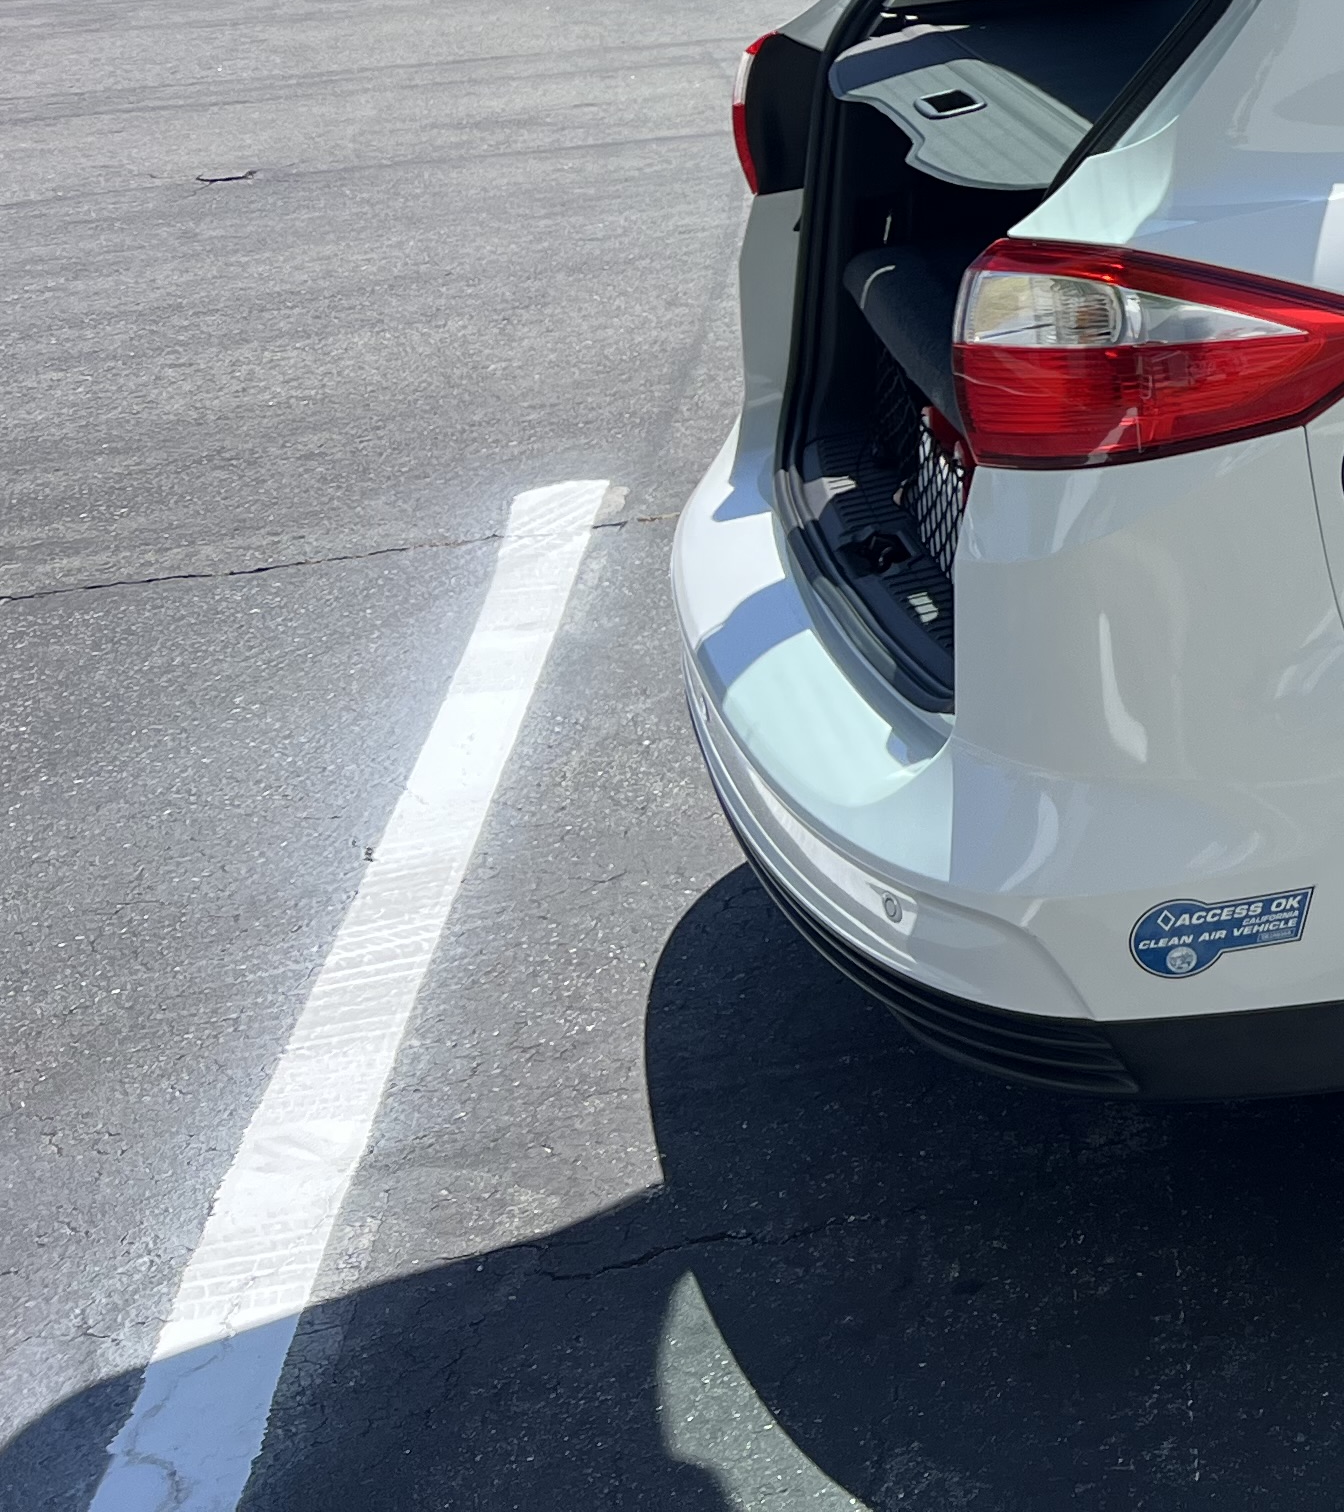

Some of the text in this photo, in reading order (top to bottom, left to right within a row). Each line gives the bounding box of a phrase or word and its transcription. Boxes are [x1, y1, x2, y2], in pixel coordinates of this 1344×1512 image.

[1174, 895, 1302, 927] ACCESS OK
[1242, 910, 1299, 925] CALIFORNIA
[1138, 934, 1193, 949] CLEAN
[1198, 930, 1227, 942] AIR
[1233, 918, 1298, 936] VEHICLE
